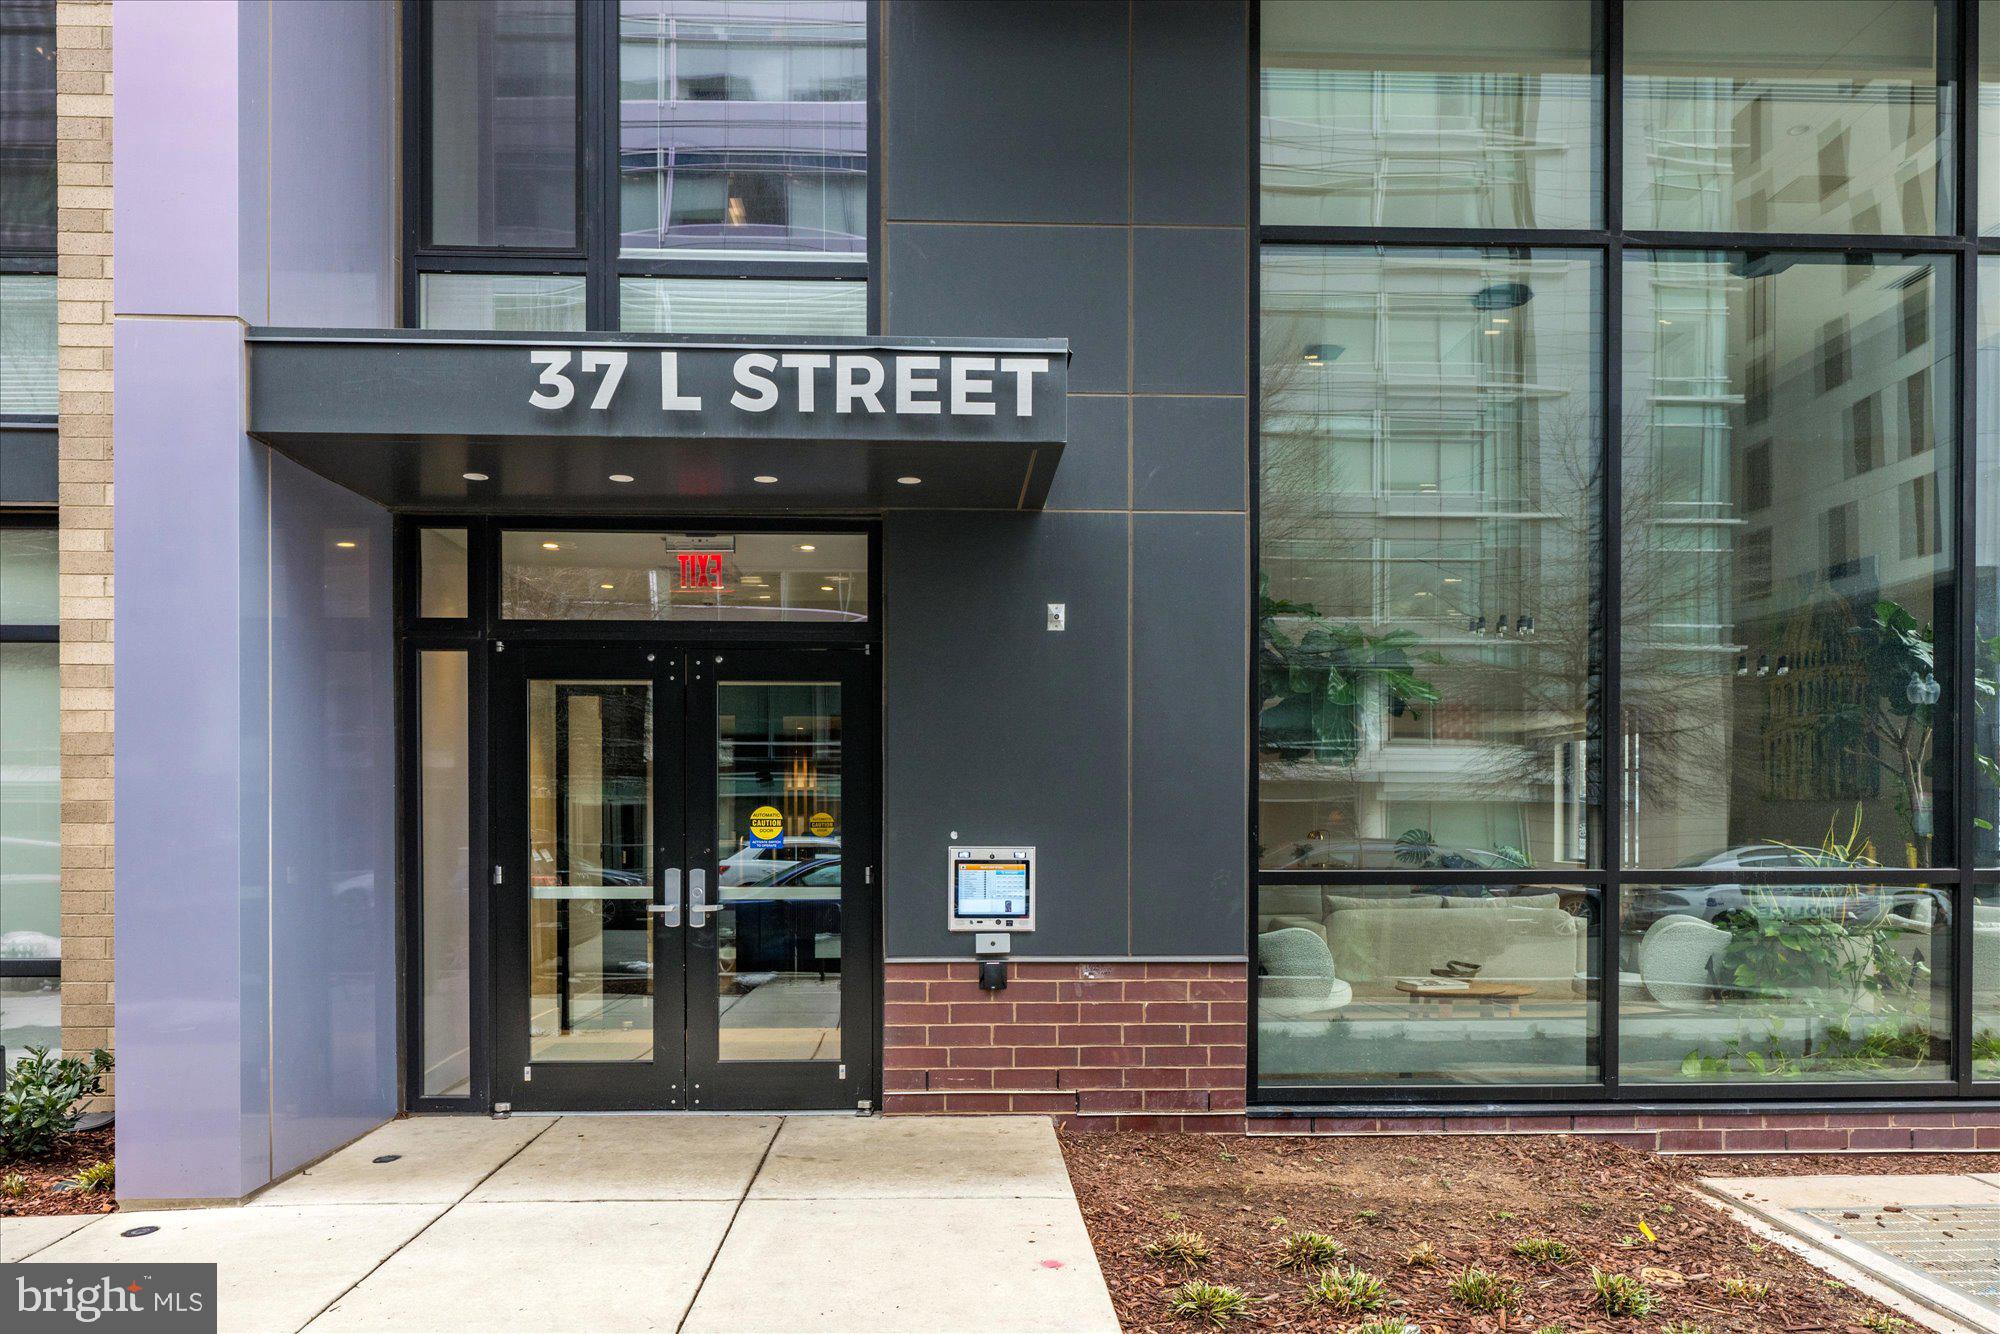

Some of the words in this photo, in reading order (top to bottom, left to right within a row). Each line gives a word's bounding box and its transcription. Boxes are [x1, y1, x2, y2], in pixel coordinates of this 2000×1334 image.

[528, 350, 628, 411] 37
[661, 351, 702, 411] L
[730, 353, 1049, 417] STREET
[752, 819, 782, 827] CAUTION
